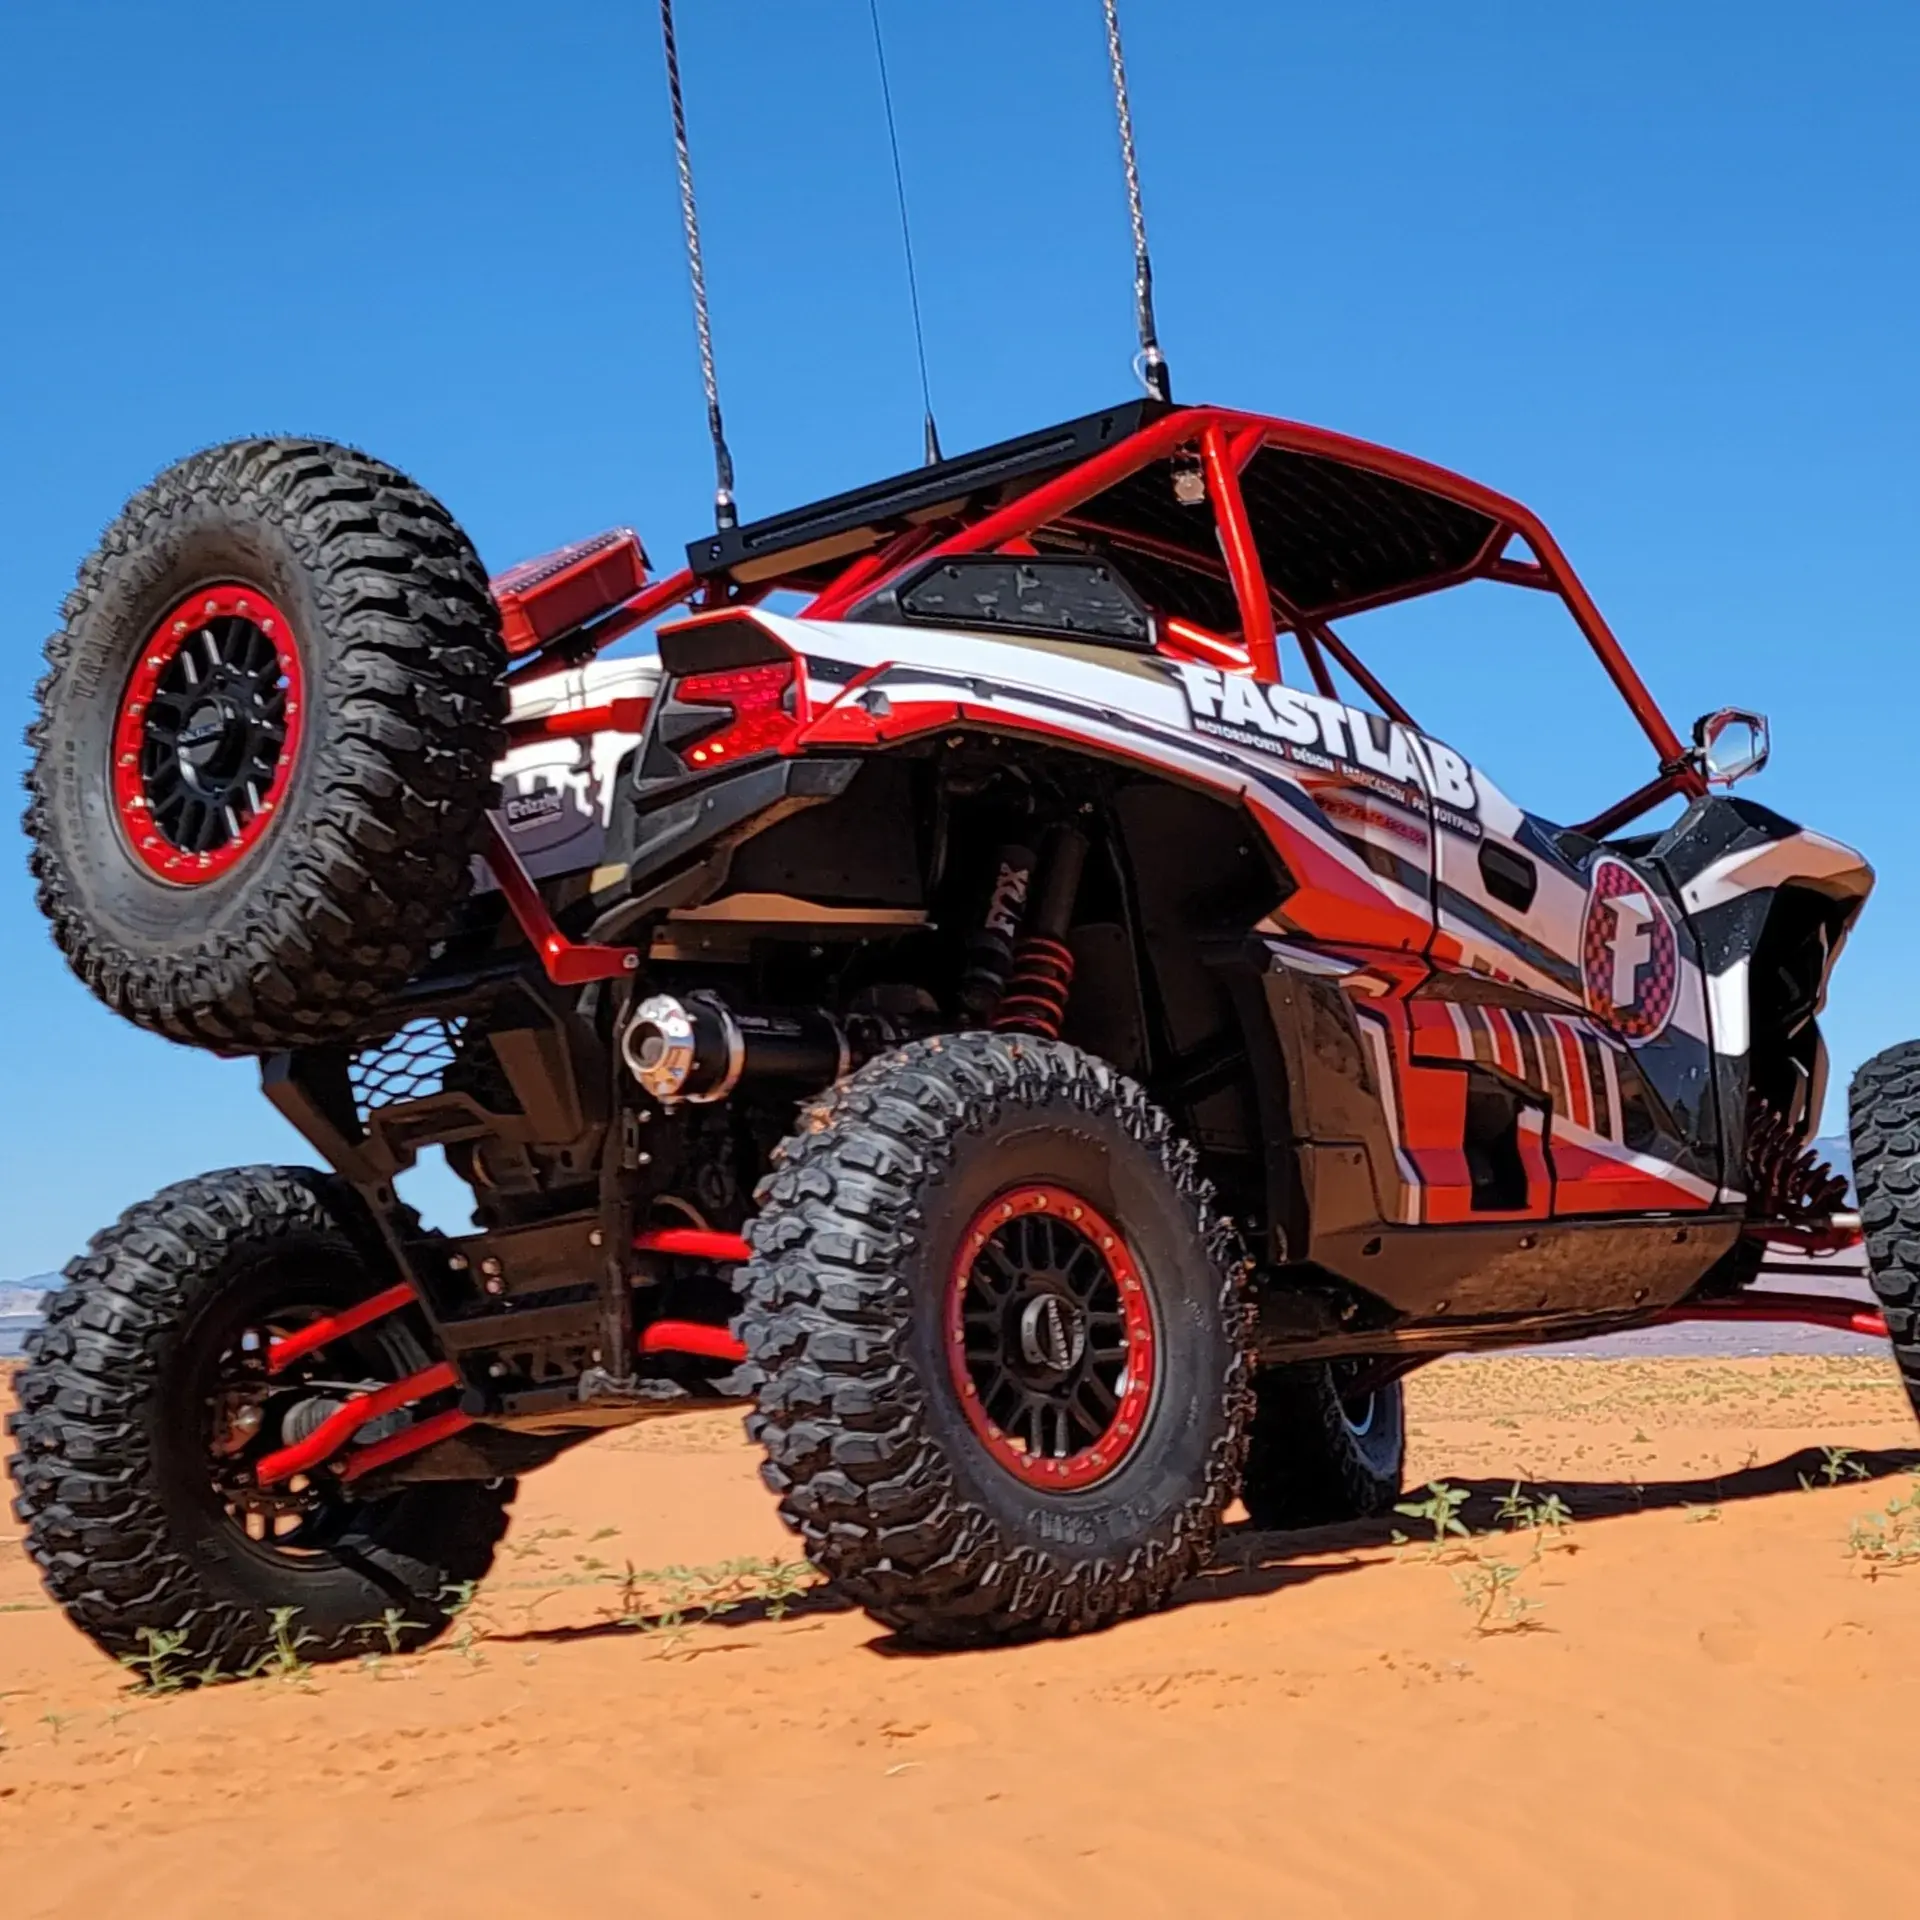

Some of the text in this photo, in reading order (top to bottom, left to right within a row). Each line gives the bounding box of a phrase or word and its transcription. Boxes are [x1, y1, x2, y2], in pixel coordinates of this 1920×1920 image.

[1171, 659, 1476, 811] FASTLAB
[1194, 717, 1284, 757] MOTORSPORTS
[1293, 745, 1333, 772] DESIGN
